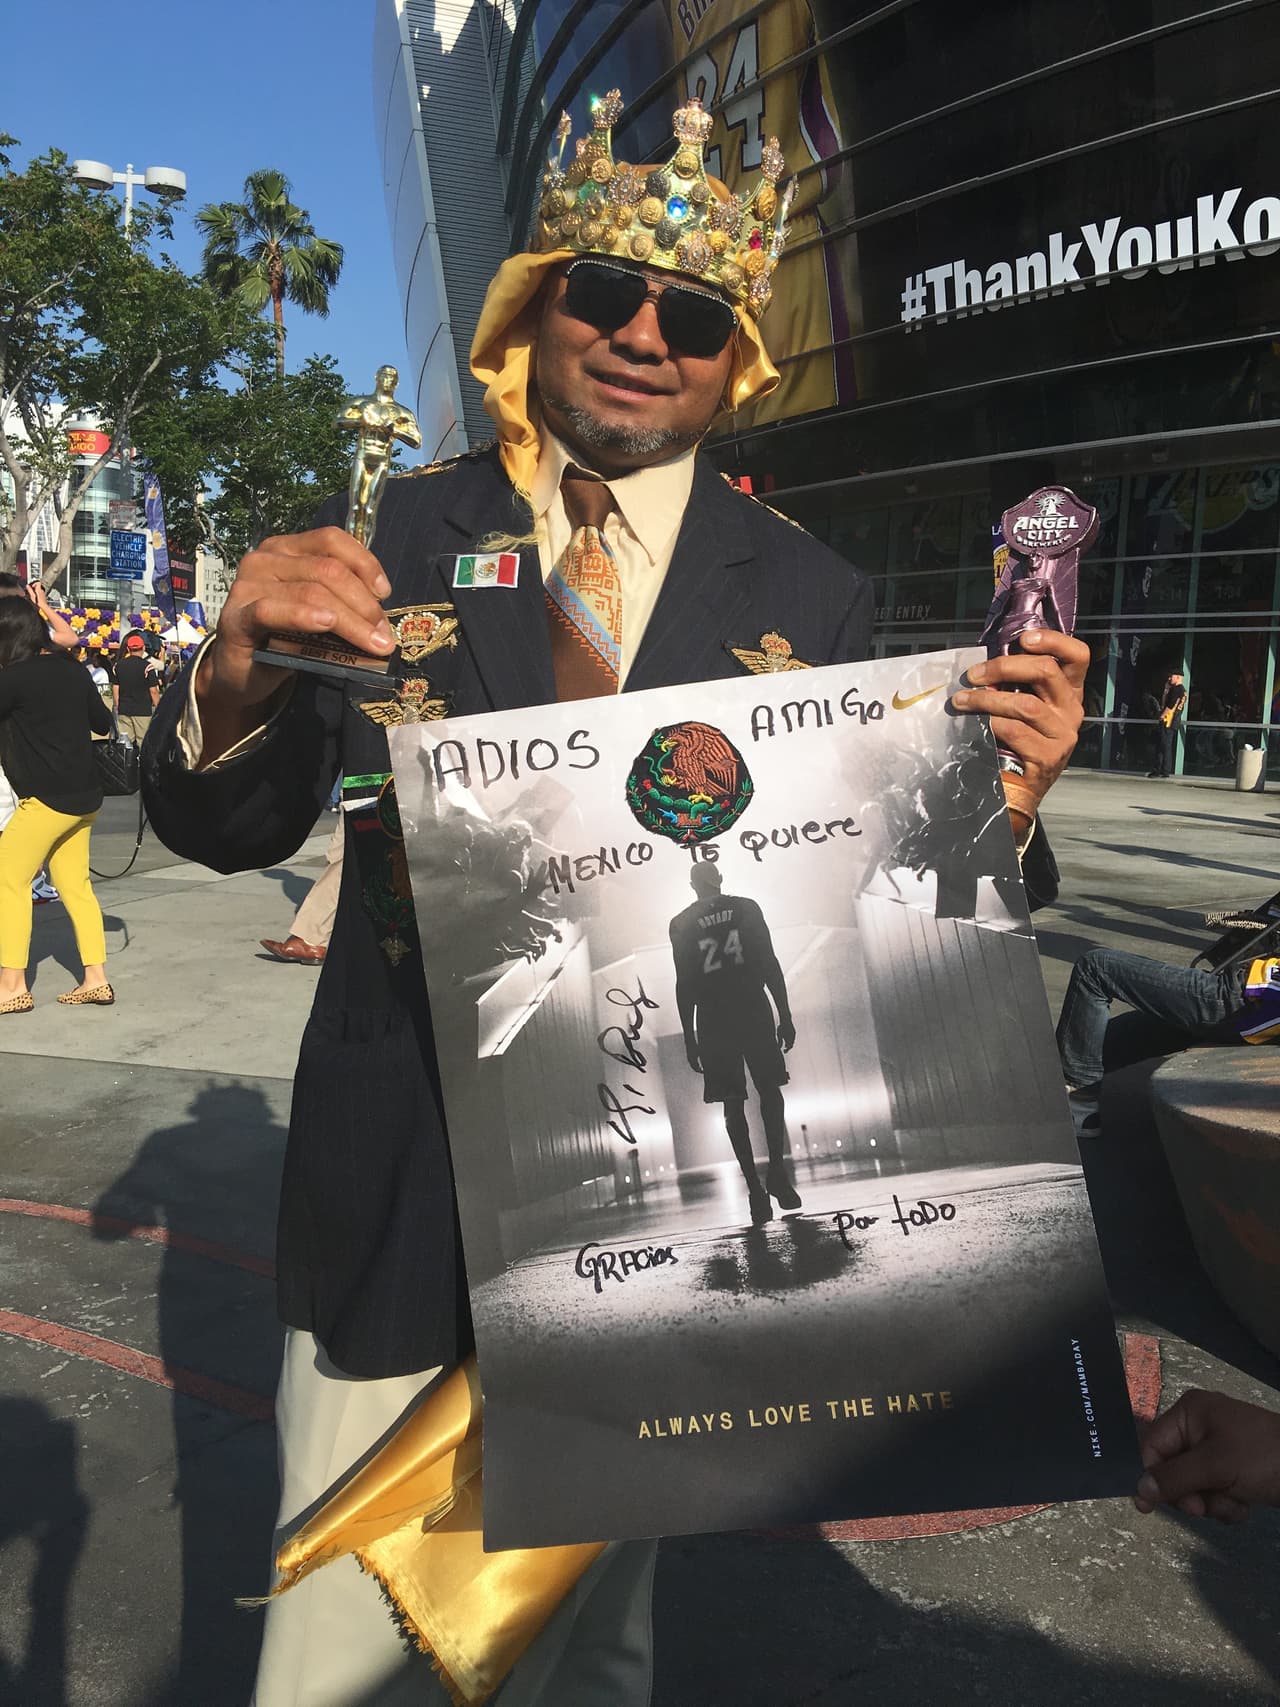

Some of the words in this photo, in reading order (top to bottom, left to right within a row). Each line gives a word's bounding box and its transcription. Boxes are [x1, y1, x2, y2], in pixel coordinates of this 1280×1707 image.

[1012, 515, 1079, 534] ANGEL
[112, 533, 145, 544] ELECTRIC
[1027, 529, 1064, 541] CITY
[114, 541, 143, 552] VEHICLE
[111, 550, 146, 561] CHARGING
[114, 559, 143, 569] STATION
[895, 604, 931, 620] ENTRY
[330, 653, 358, 666] SON
[432, 729, 600, 792] ADIOS
[549, 842, 654, 894] MEXICO
[697, 929, 745, 974] 24
[1070, 1338, 1101, 1458] NIKE.COM/MAMBADAY
[638, 1411, 734, 1440] ALWAYS
[748, 1403, 812, 1429] LOVE
[826, 1397, 875, 1420] THE
[887, 1390, 955, 1415] HATE
